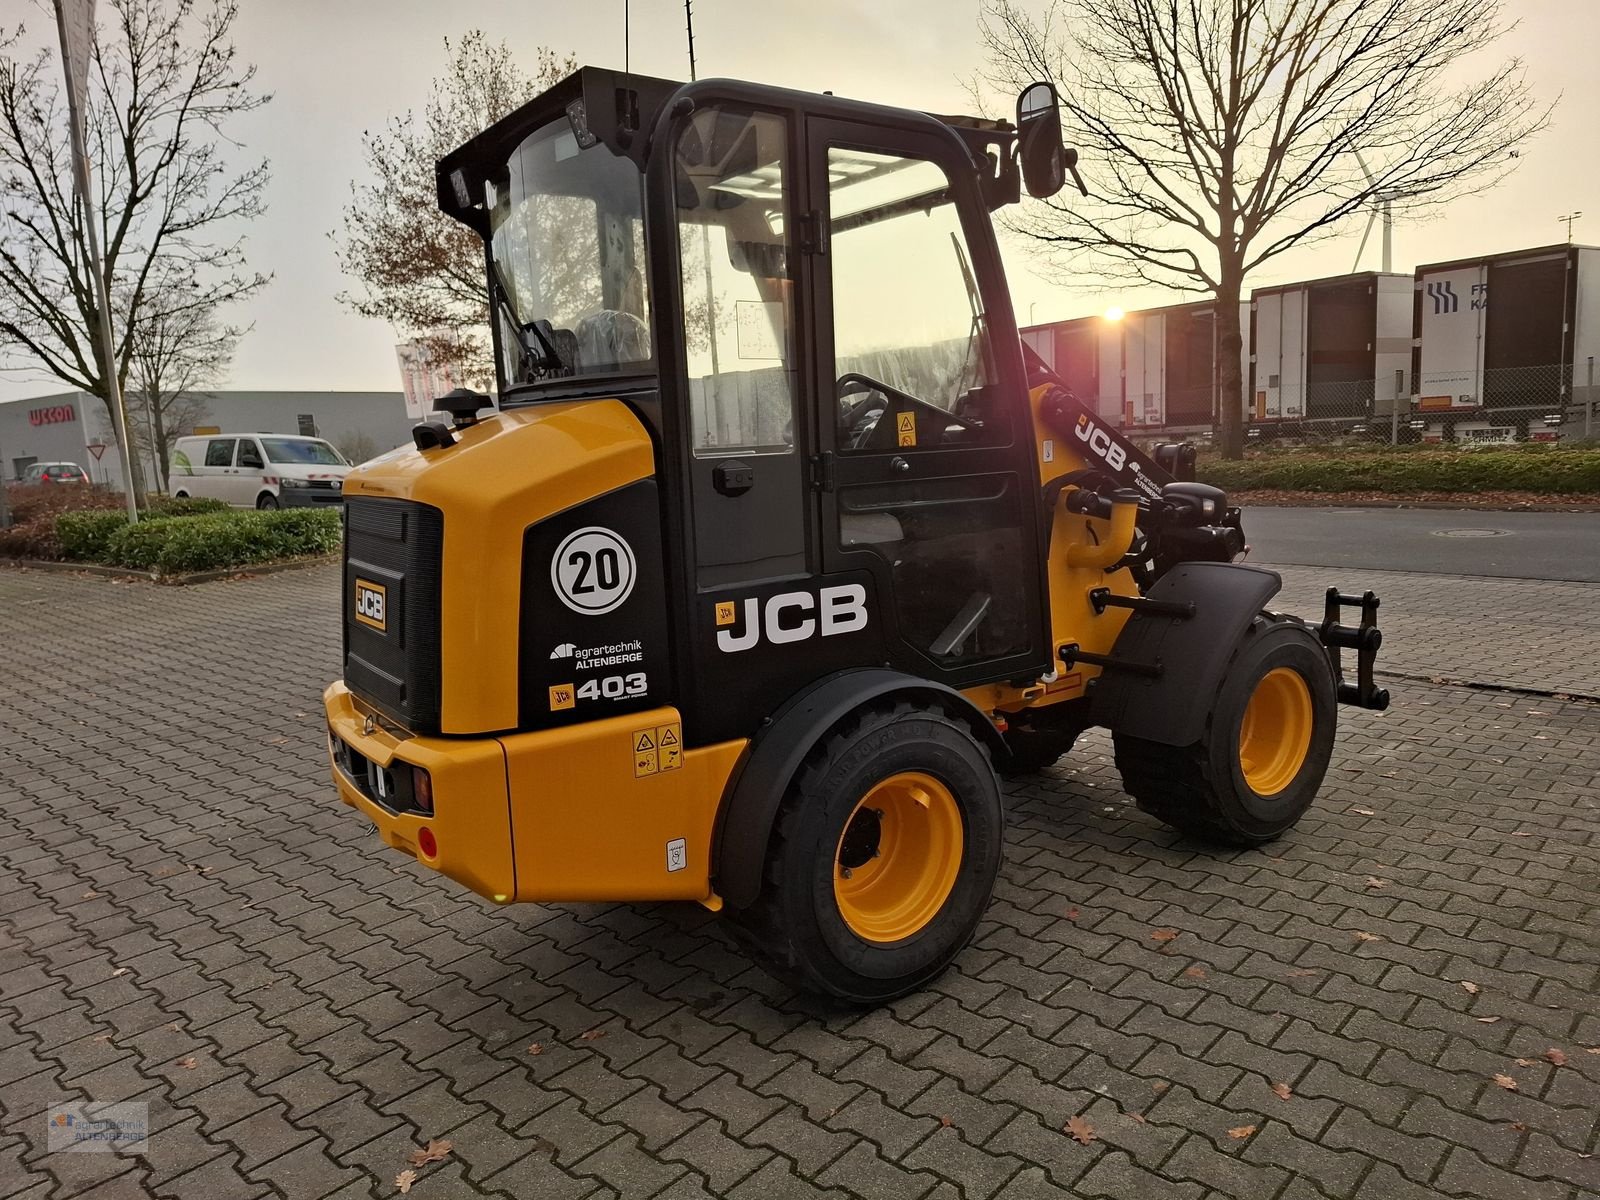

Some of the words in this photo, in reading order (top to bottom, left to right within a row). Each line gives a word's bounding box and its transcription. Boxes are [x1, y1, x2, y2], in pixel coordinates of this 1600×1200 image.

[1075, 420, 1127, 472] JCB
[569, 548, 620, 595] 20
[357, 587, 384, 621] JCB
[716, 584, 868, 653] JCB
[575, 640, 642, 660] agrartechnik
[576, 652, 643, 670] ALTENBERGE
[577, 672, 648, 700] 403
